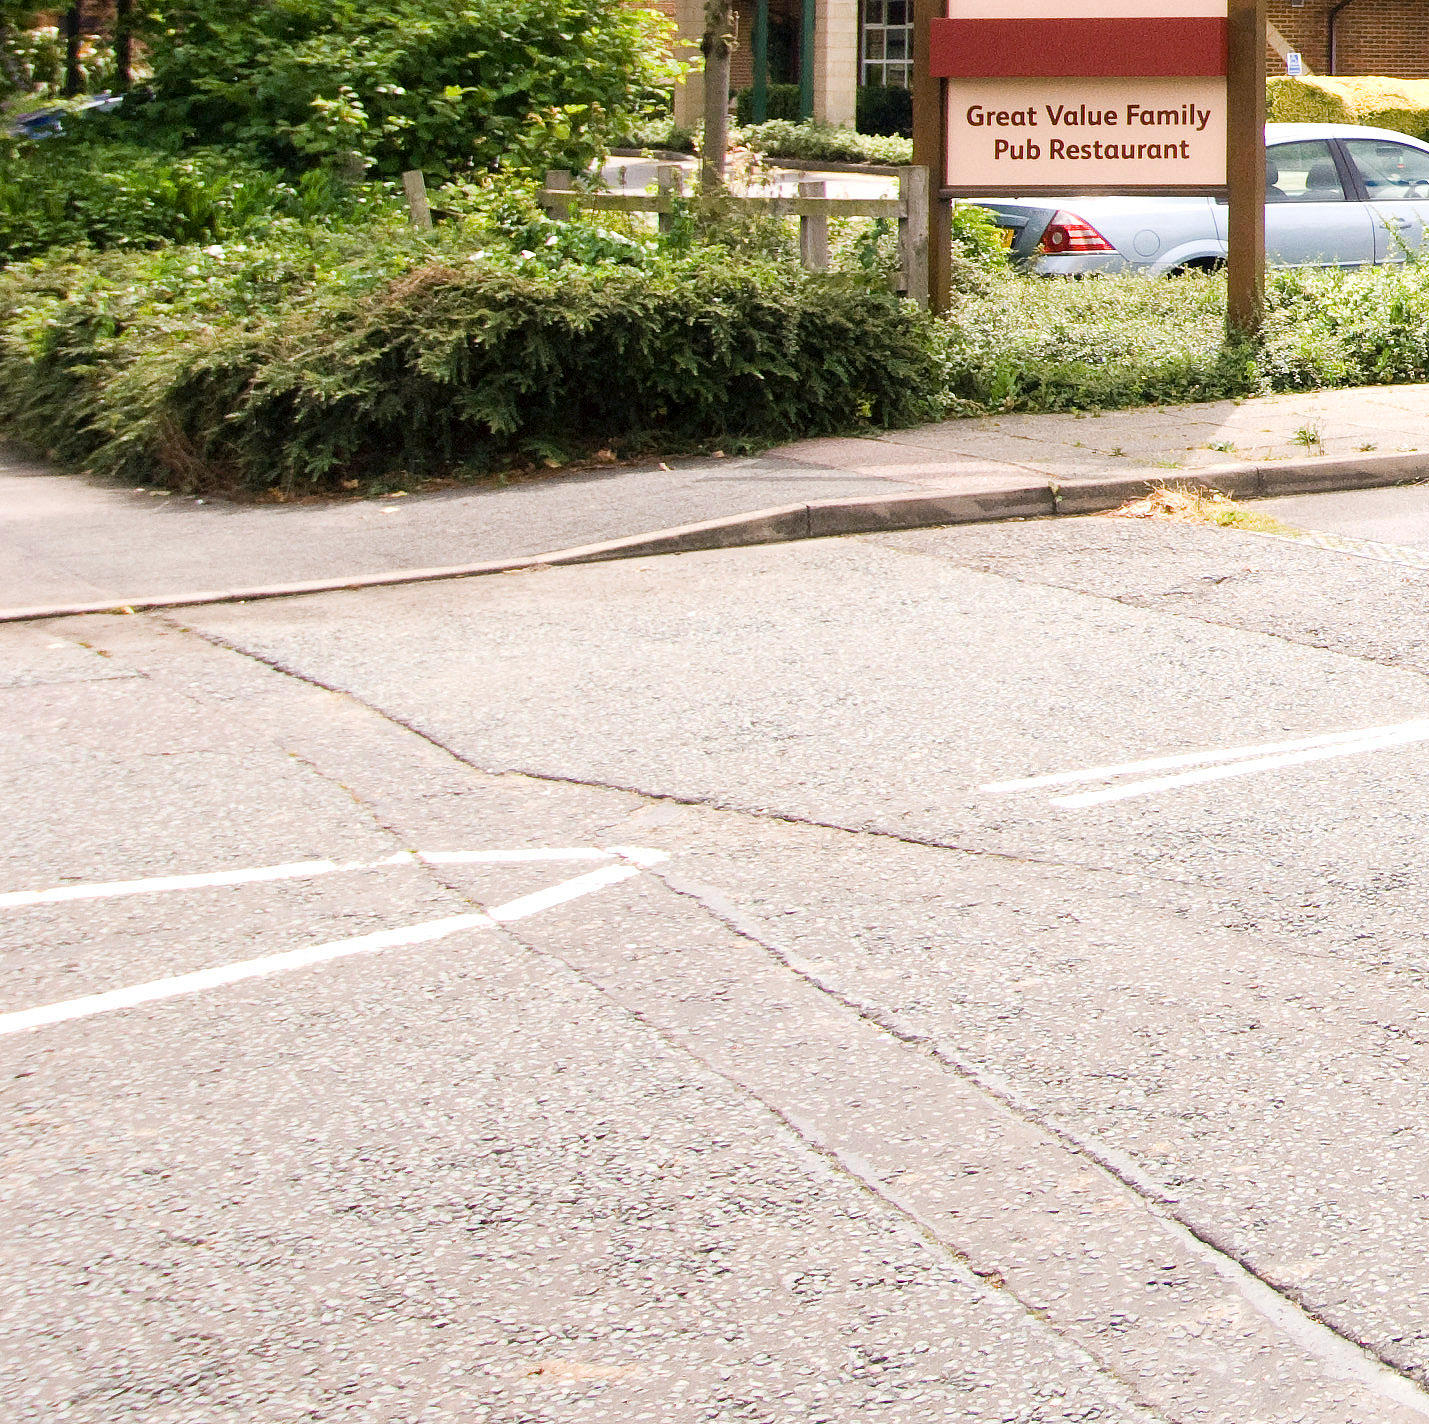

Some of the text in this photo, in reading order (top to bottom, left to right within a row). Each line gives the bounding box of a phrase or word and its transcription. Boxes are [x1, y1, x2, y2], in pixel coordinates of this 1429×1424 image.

[966, 104, 1211, 131] Great Value Family
[994, 138, 1190, 160] Pub Restaurant
